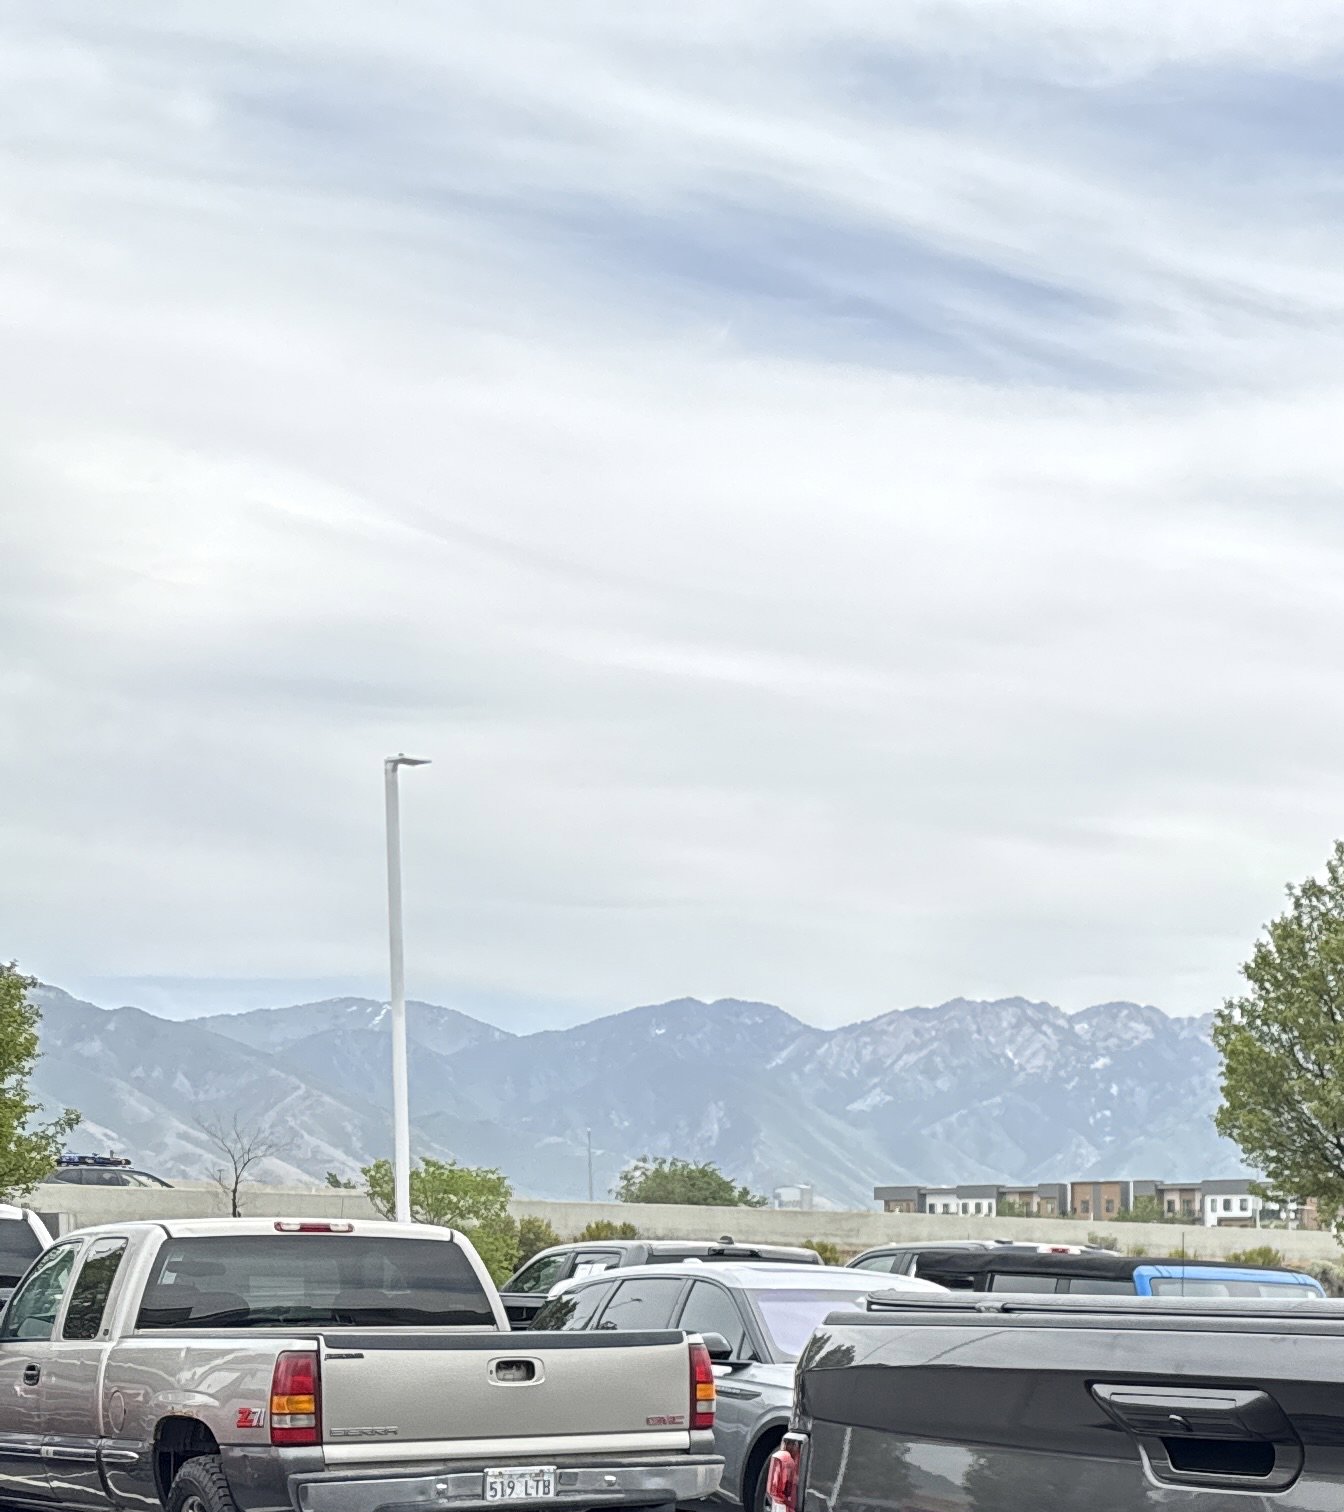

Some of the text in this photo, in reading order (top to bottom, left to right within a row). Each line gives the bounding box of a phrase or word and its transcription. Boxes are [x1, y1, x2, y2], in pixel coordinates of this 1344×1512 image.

[236, 1407, 266, 1428] Z71
[489, 1479, 551, 1498] 519 LTB
